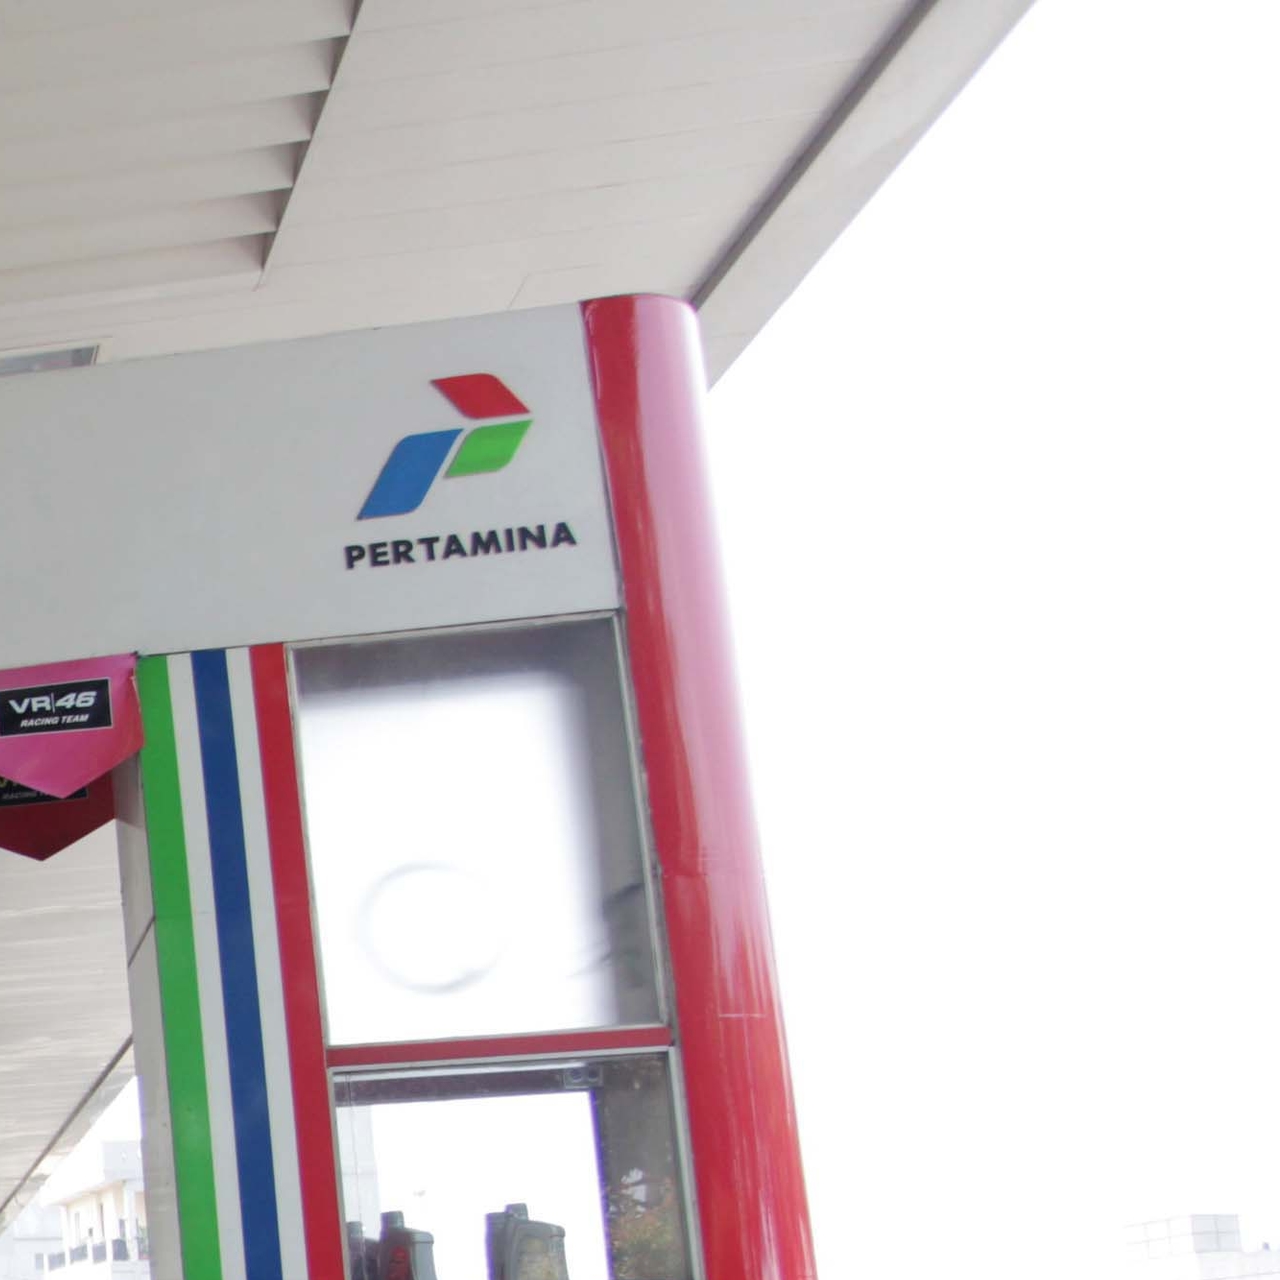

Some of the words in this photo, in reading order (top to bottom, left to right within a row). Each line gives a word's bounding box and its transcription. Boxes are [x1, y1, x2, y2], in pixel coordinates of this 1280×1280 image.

[345, 522, 577, 570] PERTAMINA
[20, 716, 58, 728] RACING
[60, 714, 88, 724] TEAM
